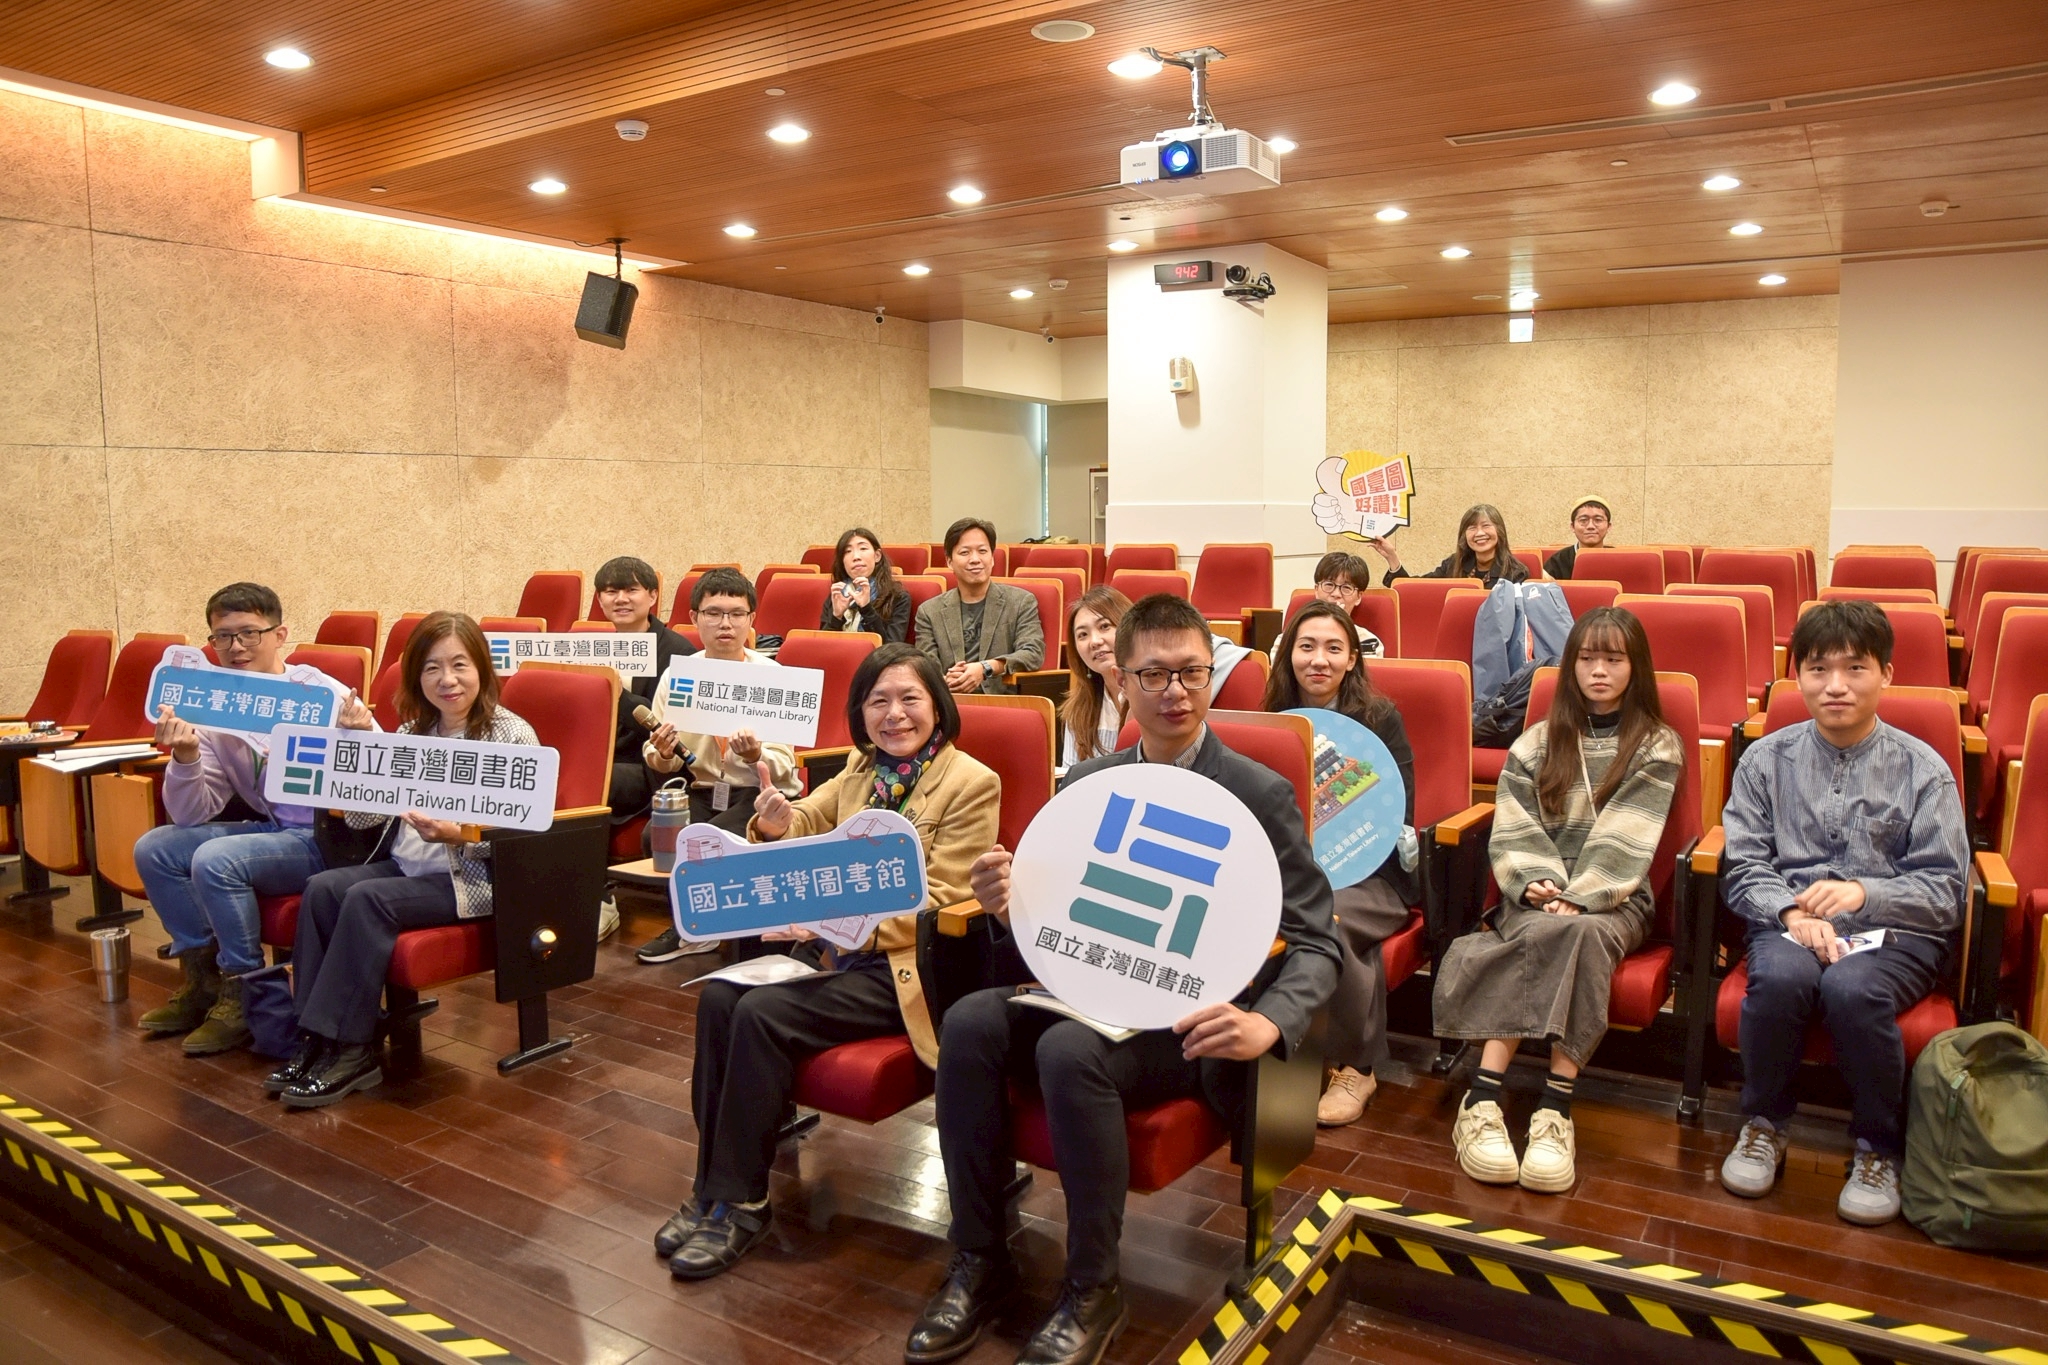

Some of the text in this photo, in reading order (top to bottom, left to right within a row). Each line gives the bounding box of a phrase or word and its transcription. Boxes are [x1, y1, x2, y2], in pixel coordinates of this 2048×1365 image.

[1350, 461, 1406, 496] 國臺圖
[1355, 494, 1398, 515] 好讚!
[516, 640, 649, 657] 國立臺灣圖書館
[160, 682, 323, 725] 國立臺灣圖書館
[696, 700, 815, 725] National Taiwan Library
[698, 680, 818, 710] 國立臺灣圖書館
[333, 739, 538, 791] 國立臺灣圖書館
[329, 780, 532, 823] National Taiwan Library
[1319, 821, 1374, 865] 國立臺灣圖書館
[1362, 833, 1379, 847] Library
[687, 856, 907, 914] 國立臺灣圖書館
[1035, 925, 1205, 1000] 國立臺灣圖書館
